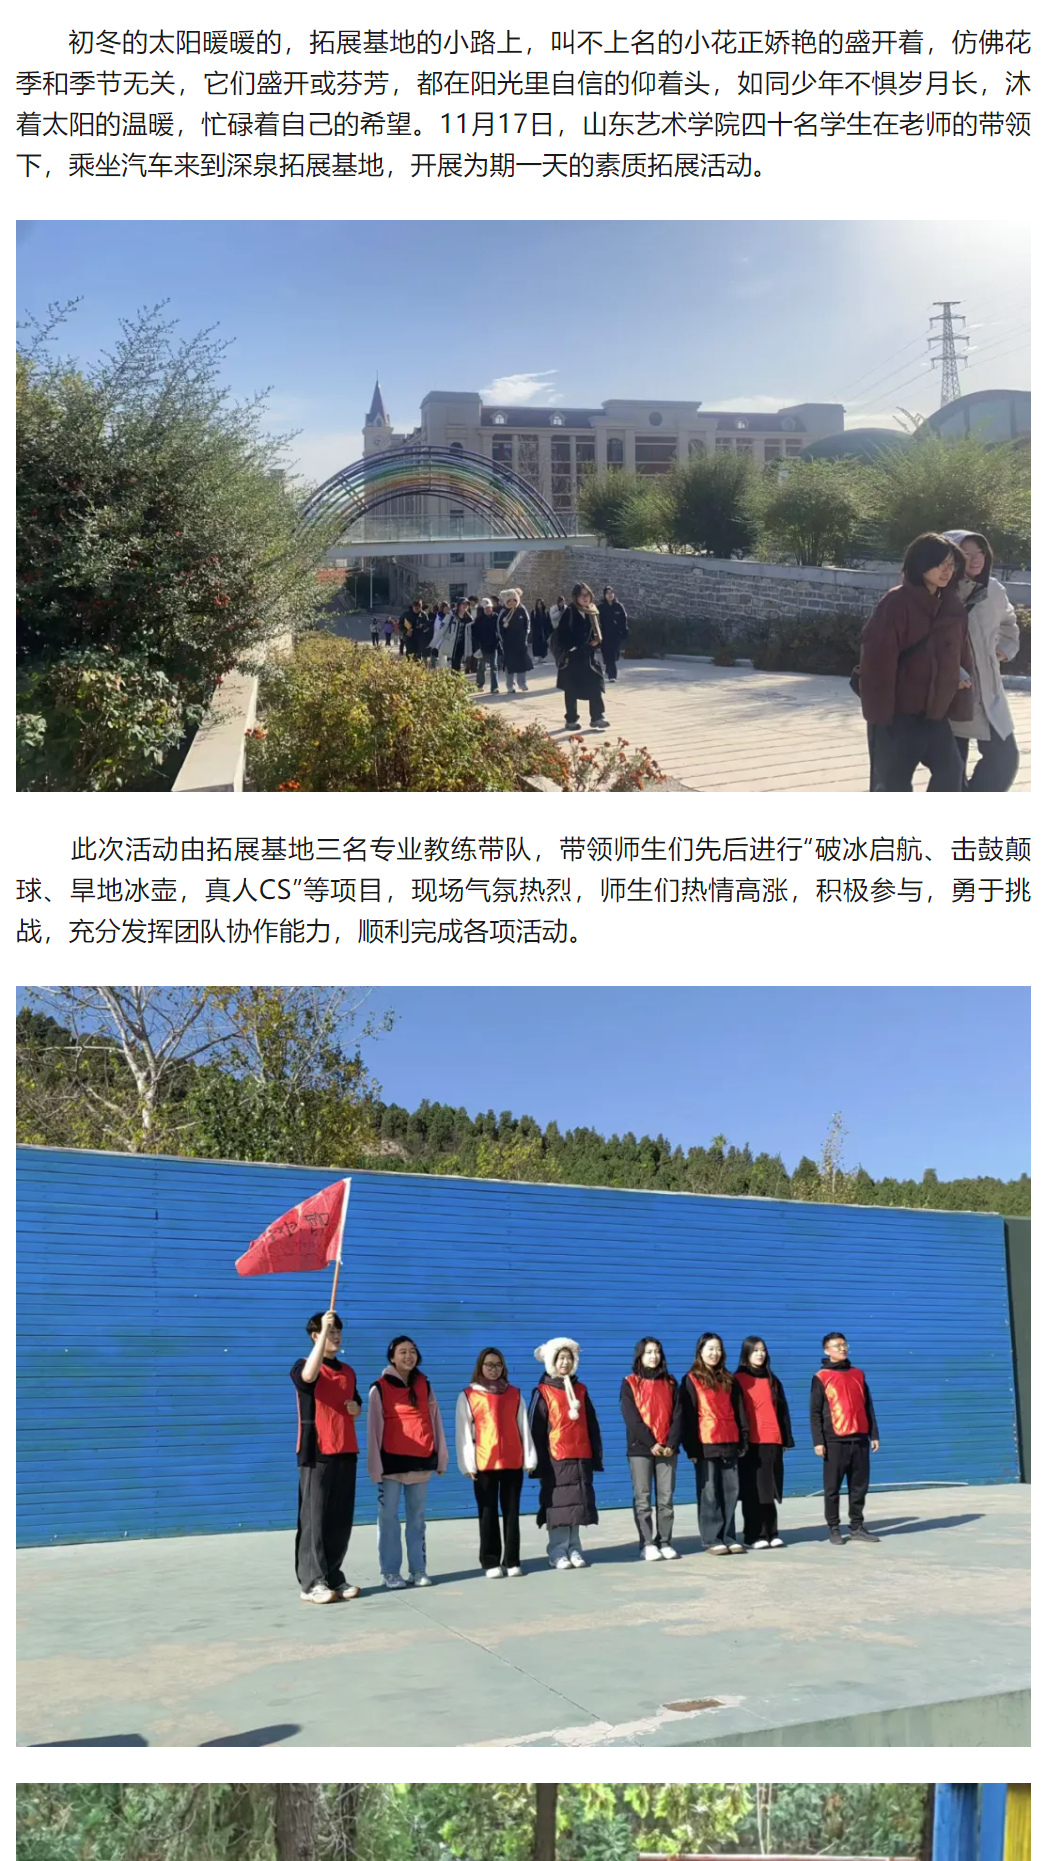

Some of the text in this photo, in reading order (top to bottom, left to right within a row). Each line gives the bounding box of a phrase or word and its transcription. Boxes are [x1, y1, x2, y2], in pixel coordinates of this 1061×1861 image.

[68, 28, 1032, 56] 初冬的太阳暖暖的，拓展基地的小路上，叫不上名的小花正娇艳的盛开着，仿佛花
[15, 69, 1032, 97] 季和季节无关，它们盛开或芬芳，都在阳光里自信的仰着头，如同少年不惧岁月长，沐
[16, 110, 1032, 138] 着太阳的温暖，忙碌着自己的希望。11月17日，山东艺术学院四十名学生在老师的带领
[16, 151, 762, 179] 下，乘坐汽车来到深泉拓展基地，开展为期一天的素质拓展活动。
[71, 835, 1032, 863] 此次活动由拓展基地三名专业教练带队，带领师生们先后进行“破冰启航、击鼓颠
[15, 876, 1032, 904] 球、旱地冰壶，真人CS”等项目，现场气氛热烈，师生们热情高涨，积极参与，勇于挑
[16, 917, 578, 945] 战，充分发挥团队协作能力，顺利完成各项活动。
